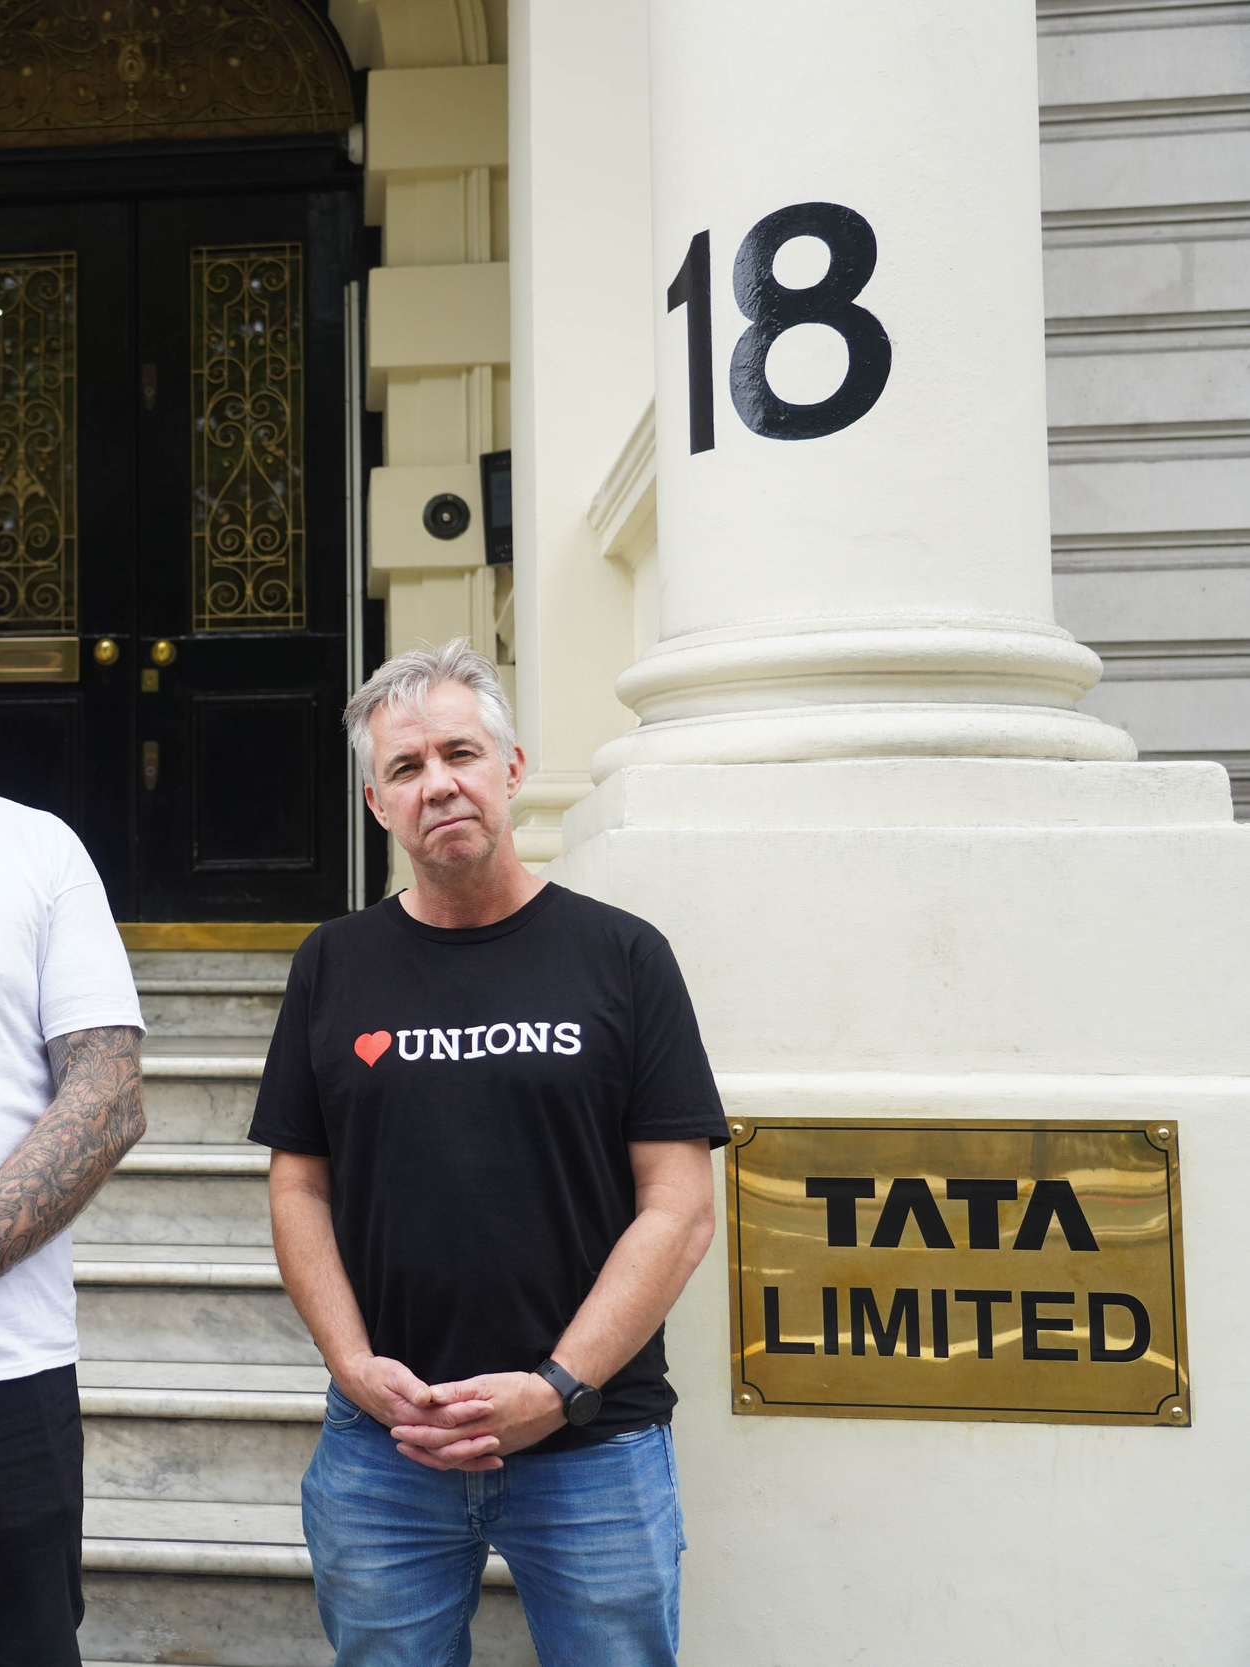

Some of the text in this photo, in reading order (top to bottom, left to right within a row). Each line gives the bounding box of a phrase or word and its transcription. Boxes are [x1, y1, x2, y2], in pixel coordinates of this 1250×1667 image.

[666, 202, 892, 456] 18
[396, 1022, 582, 1061] UNIONS
[805, 1177, 1100, 1252] TATA
[763, 1286, 1152, 1364] LIMITED
